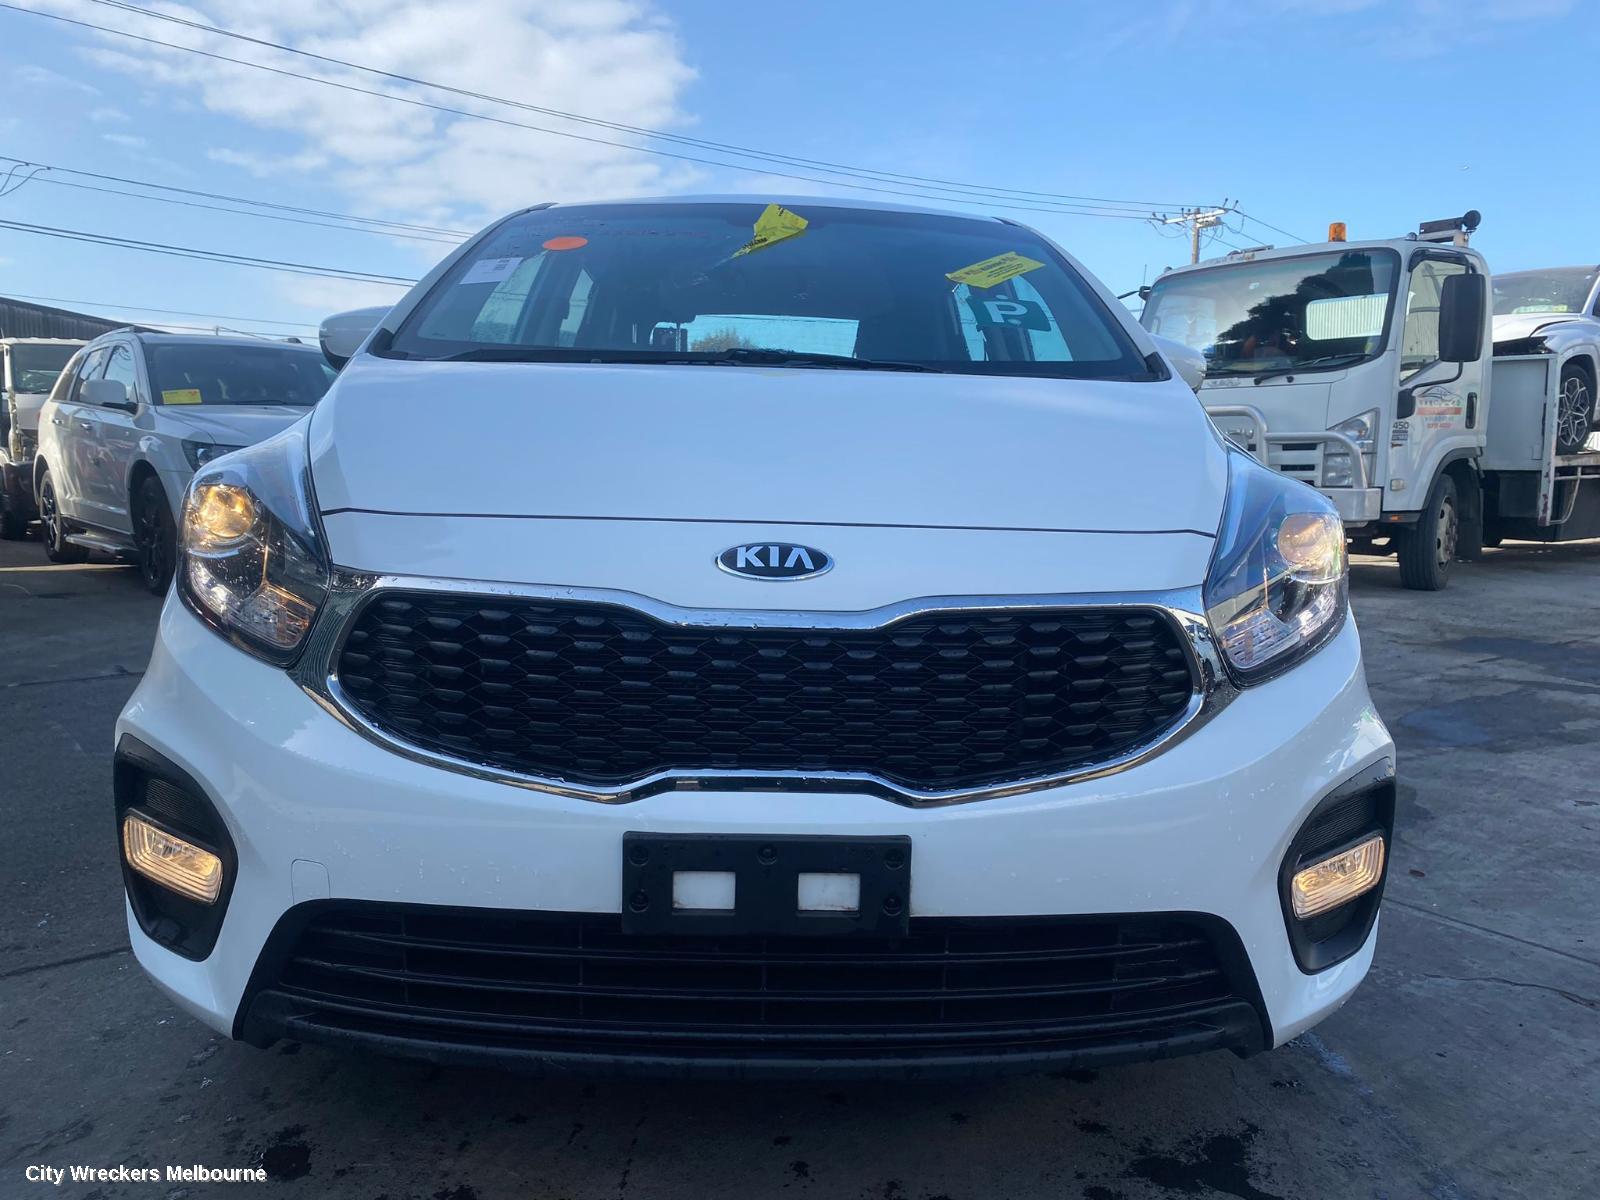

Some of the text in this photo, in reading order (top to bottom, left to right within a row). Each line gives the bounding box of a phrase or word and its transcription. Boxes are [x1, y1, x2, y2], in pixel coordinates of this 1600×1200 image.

[984, 301, 1027, 323] P
[1393, 421, 1409, 429] 450
[736, 545, 815, 570] KIA
